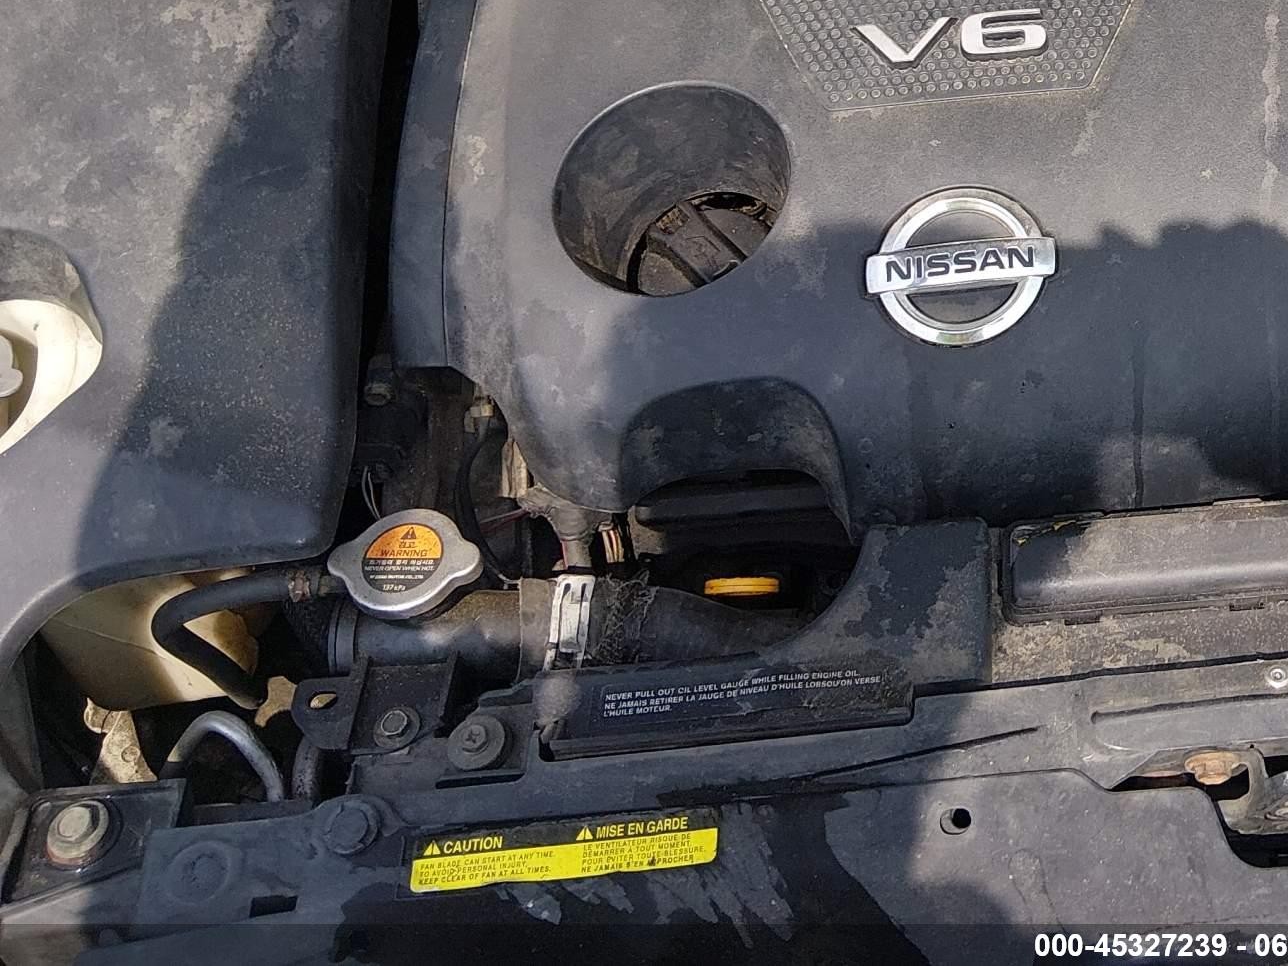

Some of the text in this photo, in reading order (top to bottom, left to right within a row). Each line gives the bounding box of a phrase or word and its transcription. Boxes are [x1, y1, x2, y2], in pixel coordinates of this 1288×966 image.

[853, 8, 1048, 65] V6
[886, 245, 1035, 283] NISSAN
[380, 549, 429, 558] WARNING
[604, 702, 616, 710] NE
[618, 699, 647, 709] JAMAIS
[649, 696, 684, 706] RETIRER
[686, 694, 696, 702] LA
[698, 691, 725, 701] JAUGE
[726, 689, 738, 698] DE
[739, 685, 769, 695] NIVEAU
[771, 681, 803, 691] D'HUILE
[854, 675, 881, 685] VERSE
[605, 692, 632, 701] NEVER
[635, 690, 655, 699] PULL
[657, 688, 675, 697] OUT
[678, 686, 691, 694] OIL
[694, 683, 718, 692] LEVEL
[720, 679, 749, 690] GAUGE
[751, 675, 776, 685] WHILE
[778, 673, 809, 682] FILLING
[811, 670, 842, 680] ENGINE
[603, 704, 672, 718] L'HUILE MOTEUR.
[596, 817, 689, 839] MISE EN GARDE
[443, 836, 503, 854] CAUTION
[583, 832, 692, 851] LE VENTILATEUR RISQUE DE
[636, 843, 655, 853] TOUT
[420, 863, 435, 871] FAN
[437, 859, 461, 869] BLADE
[464, 858, 480, 866] CAN
[482, 855, 506, 864] START
[508, 854, 517, 862] AT
[519, 852, 534, 860] ANY
[582, 857, 603, 865] POUR
[637, 850, 661, 860] TOUTE
[418, 877, 439, 885] KEEP
[441, 874, 466, 883] CLEAR
[469, 872, 479, 880] OF
[481, 871, 496, 880] FAN
[499, 869, 508, 877] AT
[510, 868, 525, 876] ALL
[432, 867, 455, 876] AVOID
[457, 863, 496, 874] PERSONAL
[581, 865, 592, 873] NE
[594, 863, 623, 872] JAMAIS
